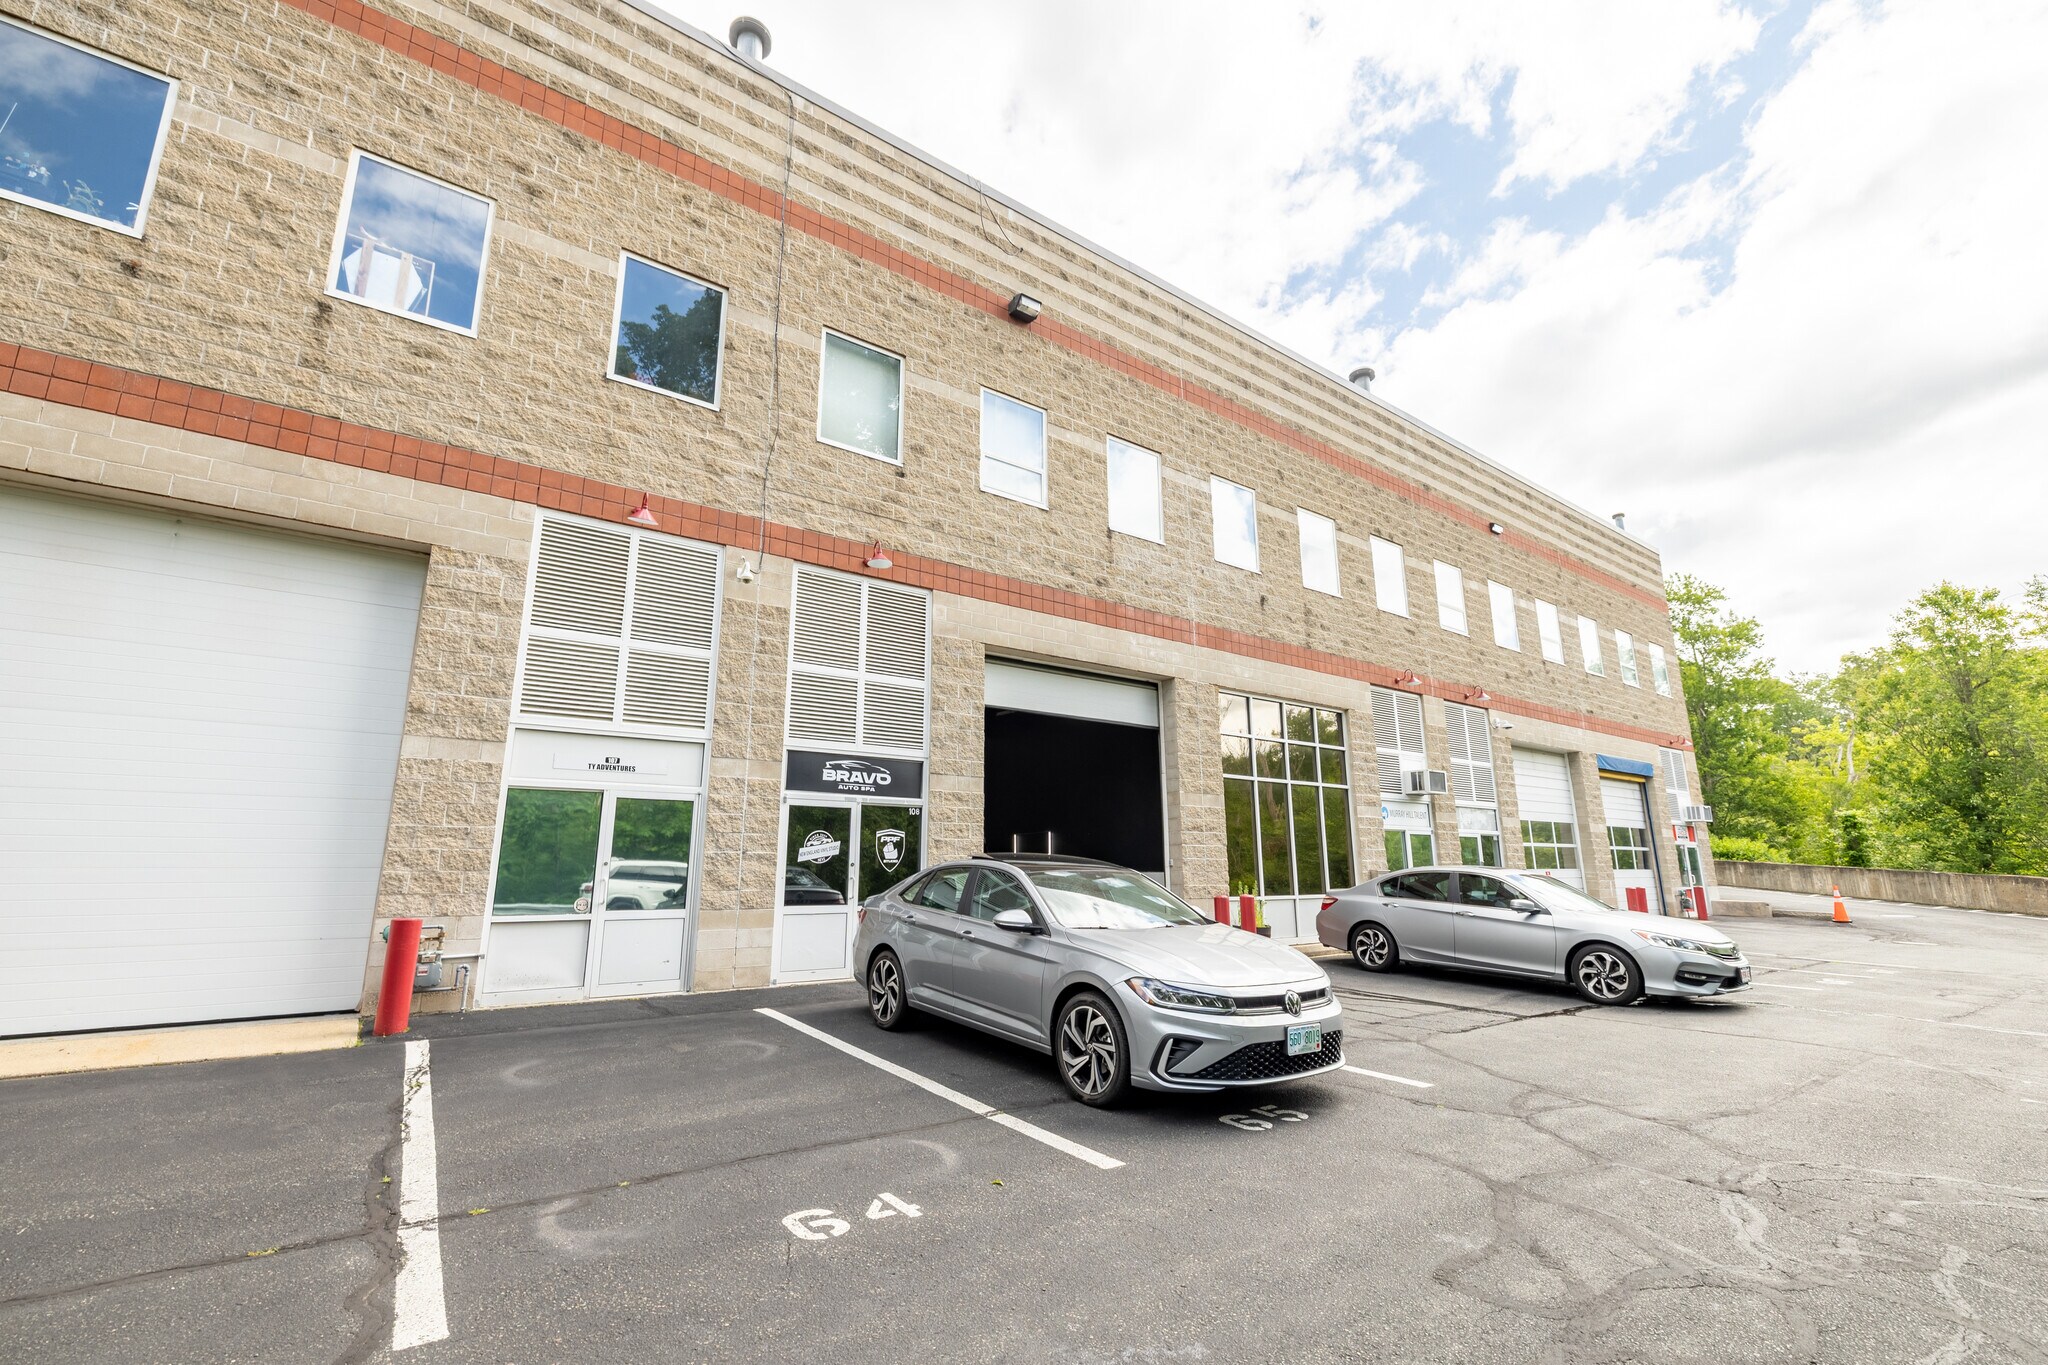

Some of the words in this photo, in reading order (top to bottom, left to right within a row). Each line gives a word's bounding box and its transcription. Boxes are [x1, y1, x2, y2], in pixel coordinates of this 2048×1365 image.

[597, 764, 636, 772] ADVENTURES
[822, 769, 892, 785] BRAVO
[1304, 1029, 1320, 1044] 8019
[1218, 1104, 1310, 1132] 65
[781, 1192, 924, 1241] 64
